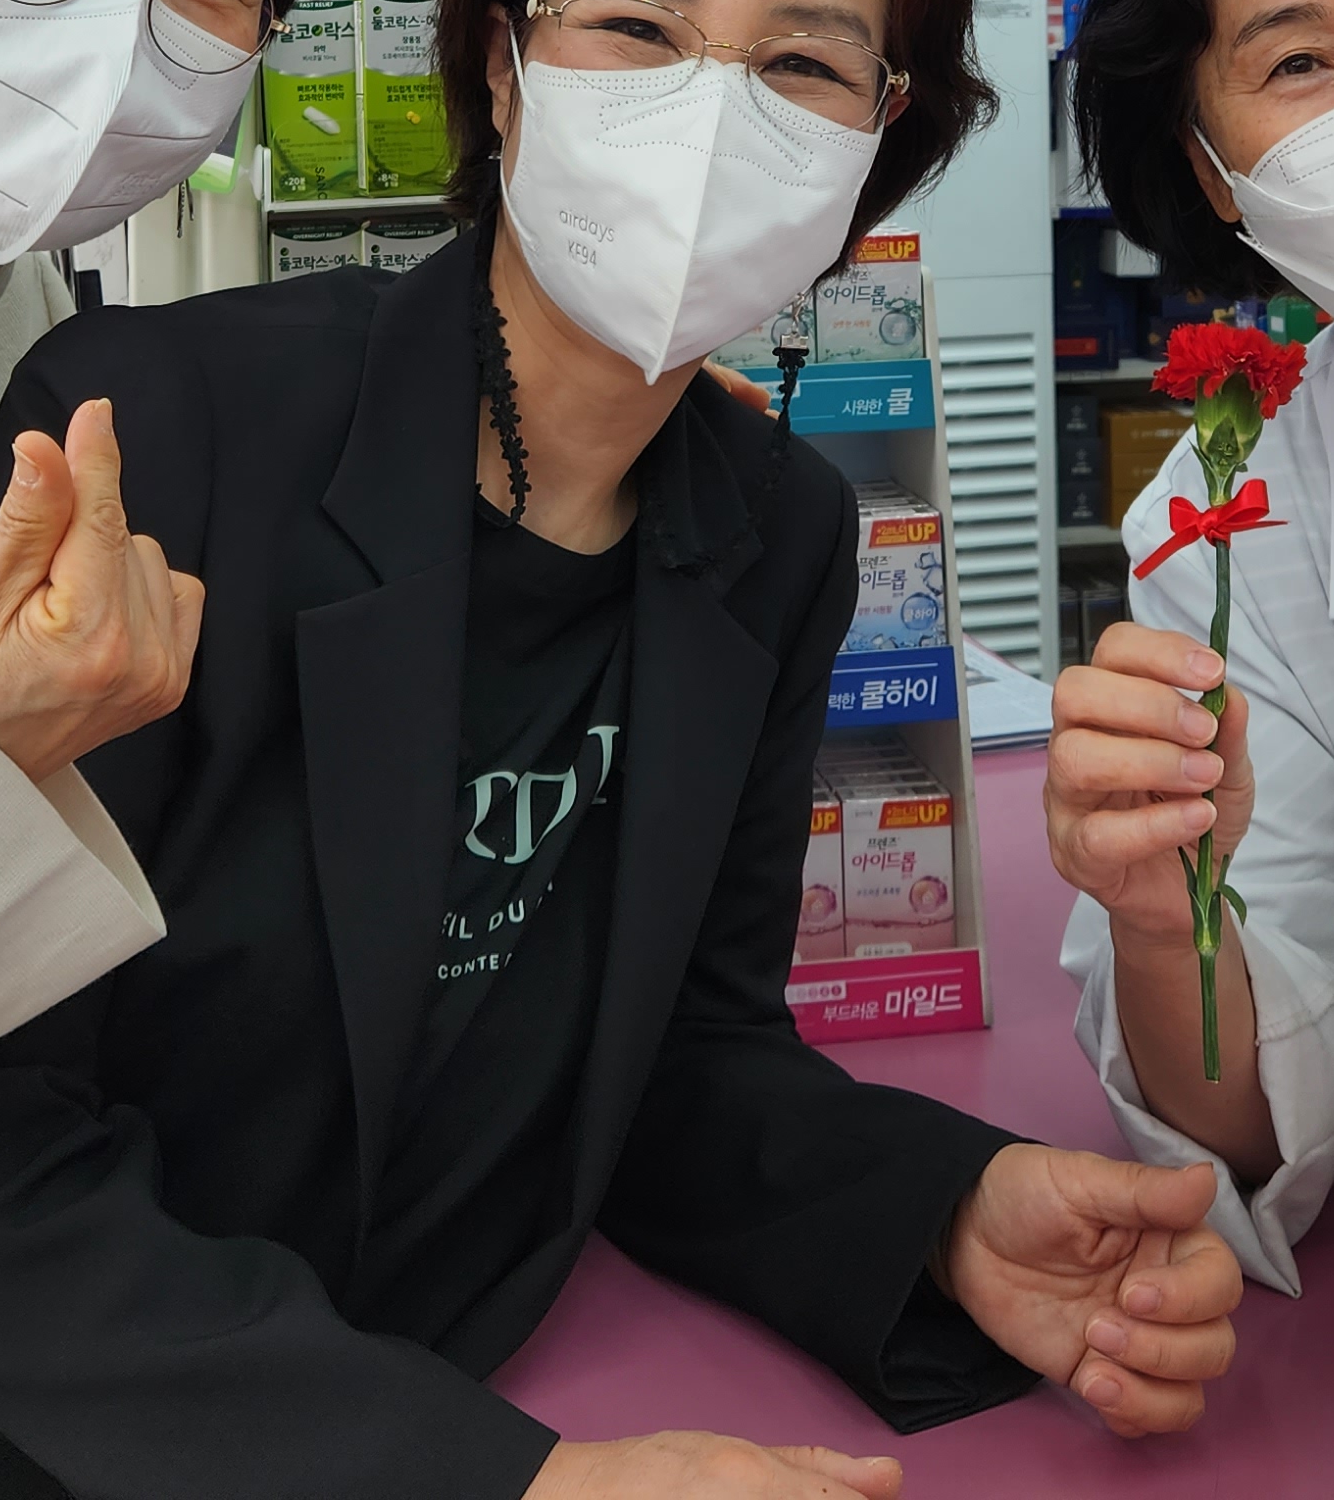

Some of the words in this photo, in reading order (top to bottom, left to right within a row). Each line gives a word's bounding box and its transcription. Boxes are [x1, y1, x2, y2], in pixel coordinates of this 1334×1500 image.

[297, 85, 317, 93] 빠르게
[318, 84, 344, 92] 작용하는
[299, 94, 323, 102] 효과적인
[559, 210, 615, 244] airdays
[568, 240, 597, 266] KF94
[888, 241, 916, 258] UP
[279, 254, 358, 272] 둘코락스-에스
[824, 286, 887, 305] 아이드롭
[842, 399, 882, 415] 시원한
[887, 388, 913, 415] 쿨
[907, 522, 936, 541] UP
[859, 570, 907, 590] 이드롭
[903, 607, 936, 620] 쿨하이
[828, 694, 856, 710] 력한
[860, 676, 937, 710] 쿨하이
[919, 804, 948, 823] UP
[868, 837, 899, 850] 프렌즈
[852, 852, 916, 872] 아이드롭
[438, 952, 512, 980] CONTE
[823, 1002, 880, 1023] 부드러운
[885, 984, 962, 1018] 마일드
